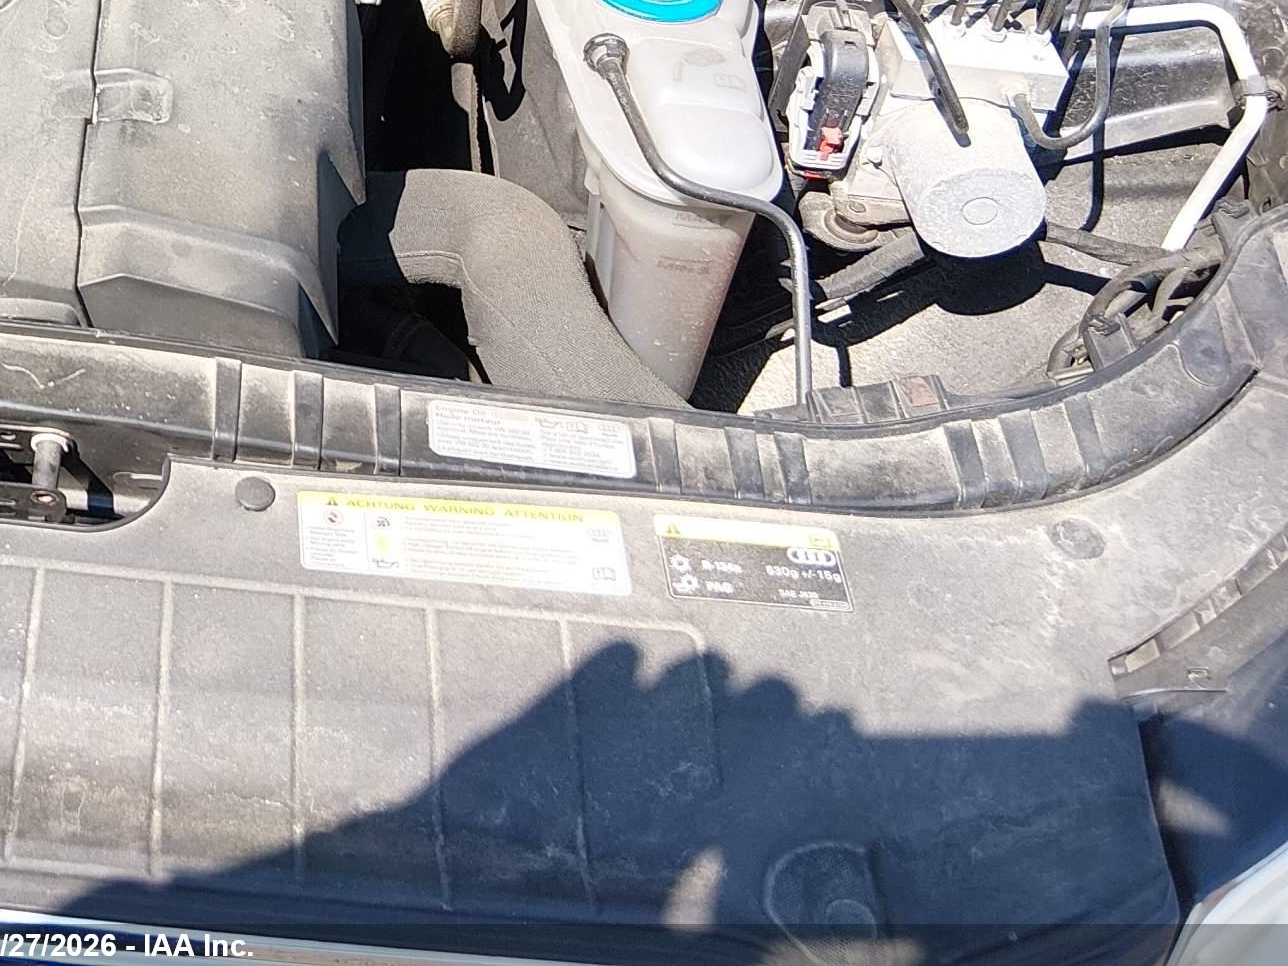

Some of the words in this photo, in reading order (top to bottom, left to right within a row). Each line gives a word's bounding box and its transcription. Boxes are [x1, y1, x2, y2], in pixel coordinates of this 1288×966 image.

[346, 498, 416, 511] ACHTUNG
[423, 503, 495, 516] WARNING
[503, 508, 583, 522] ATTENTION
